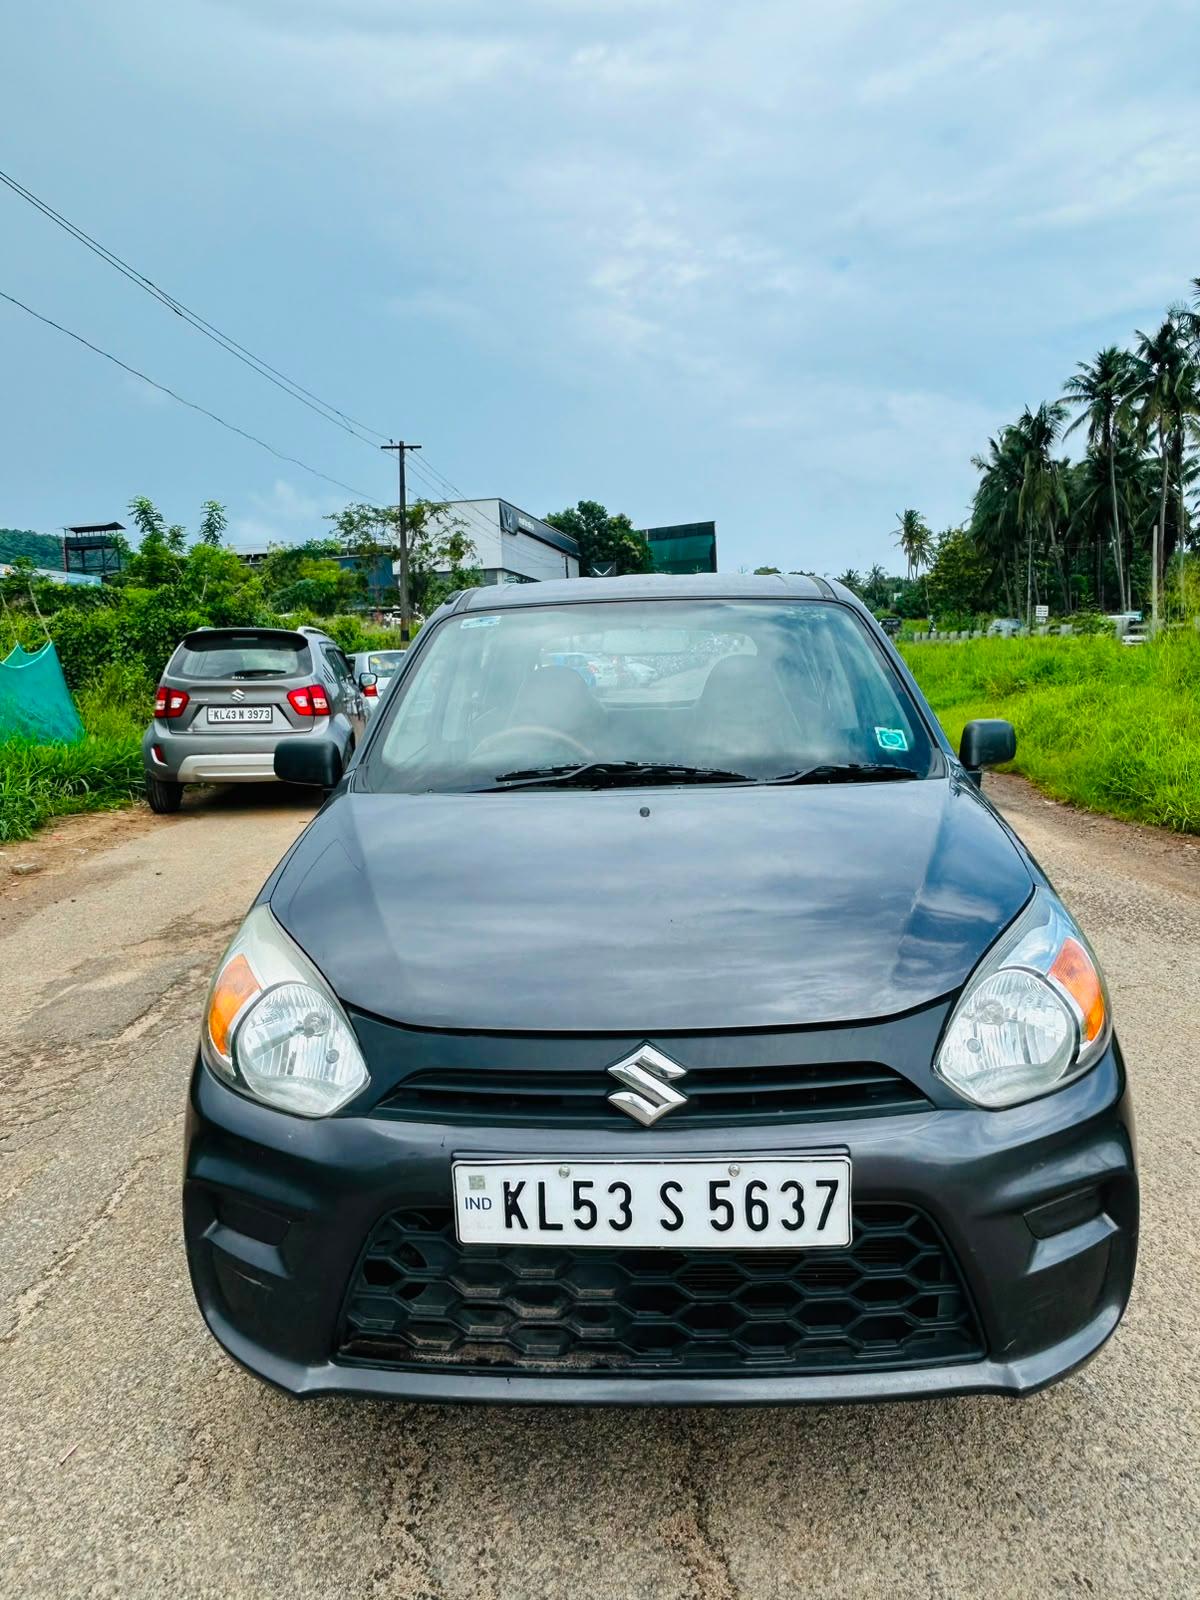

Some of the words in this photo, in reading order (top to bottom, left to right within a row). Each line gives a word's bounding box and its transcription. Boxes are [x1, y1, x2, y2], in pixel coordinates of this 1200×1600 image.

[214, 710, 236, 720] KL43
[247, 710, 270, 719] 3973
[465, 1197, 492, 1210] IND
[503, 1181, 633, 1231] KL53
[660, 1180, 684, 1232] S
[709, 1179, 839, 1232] 5637
